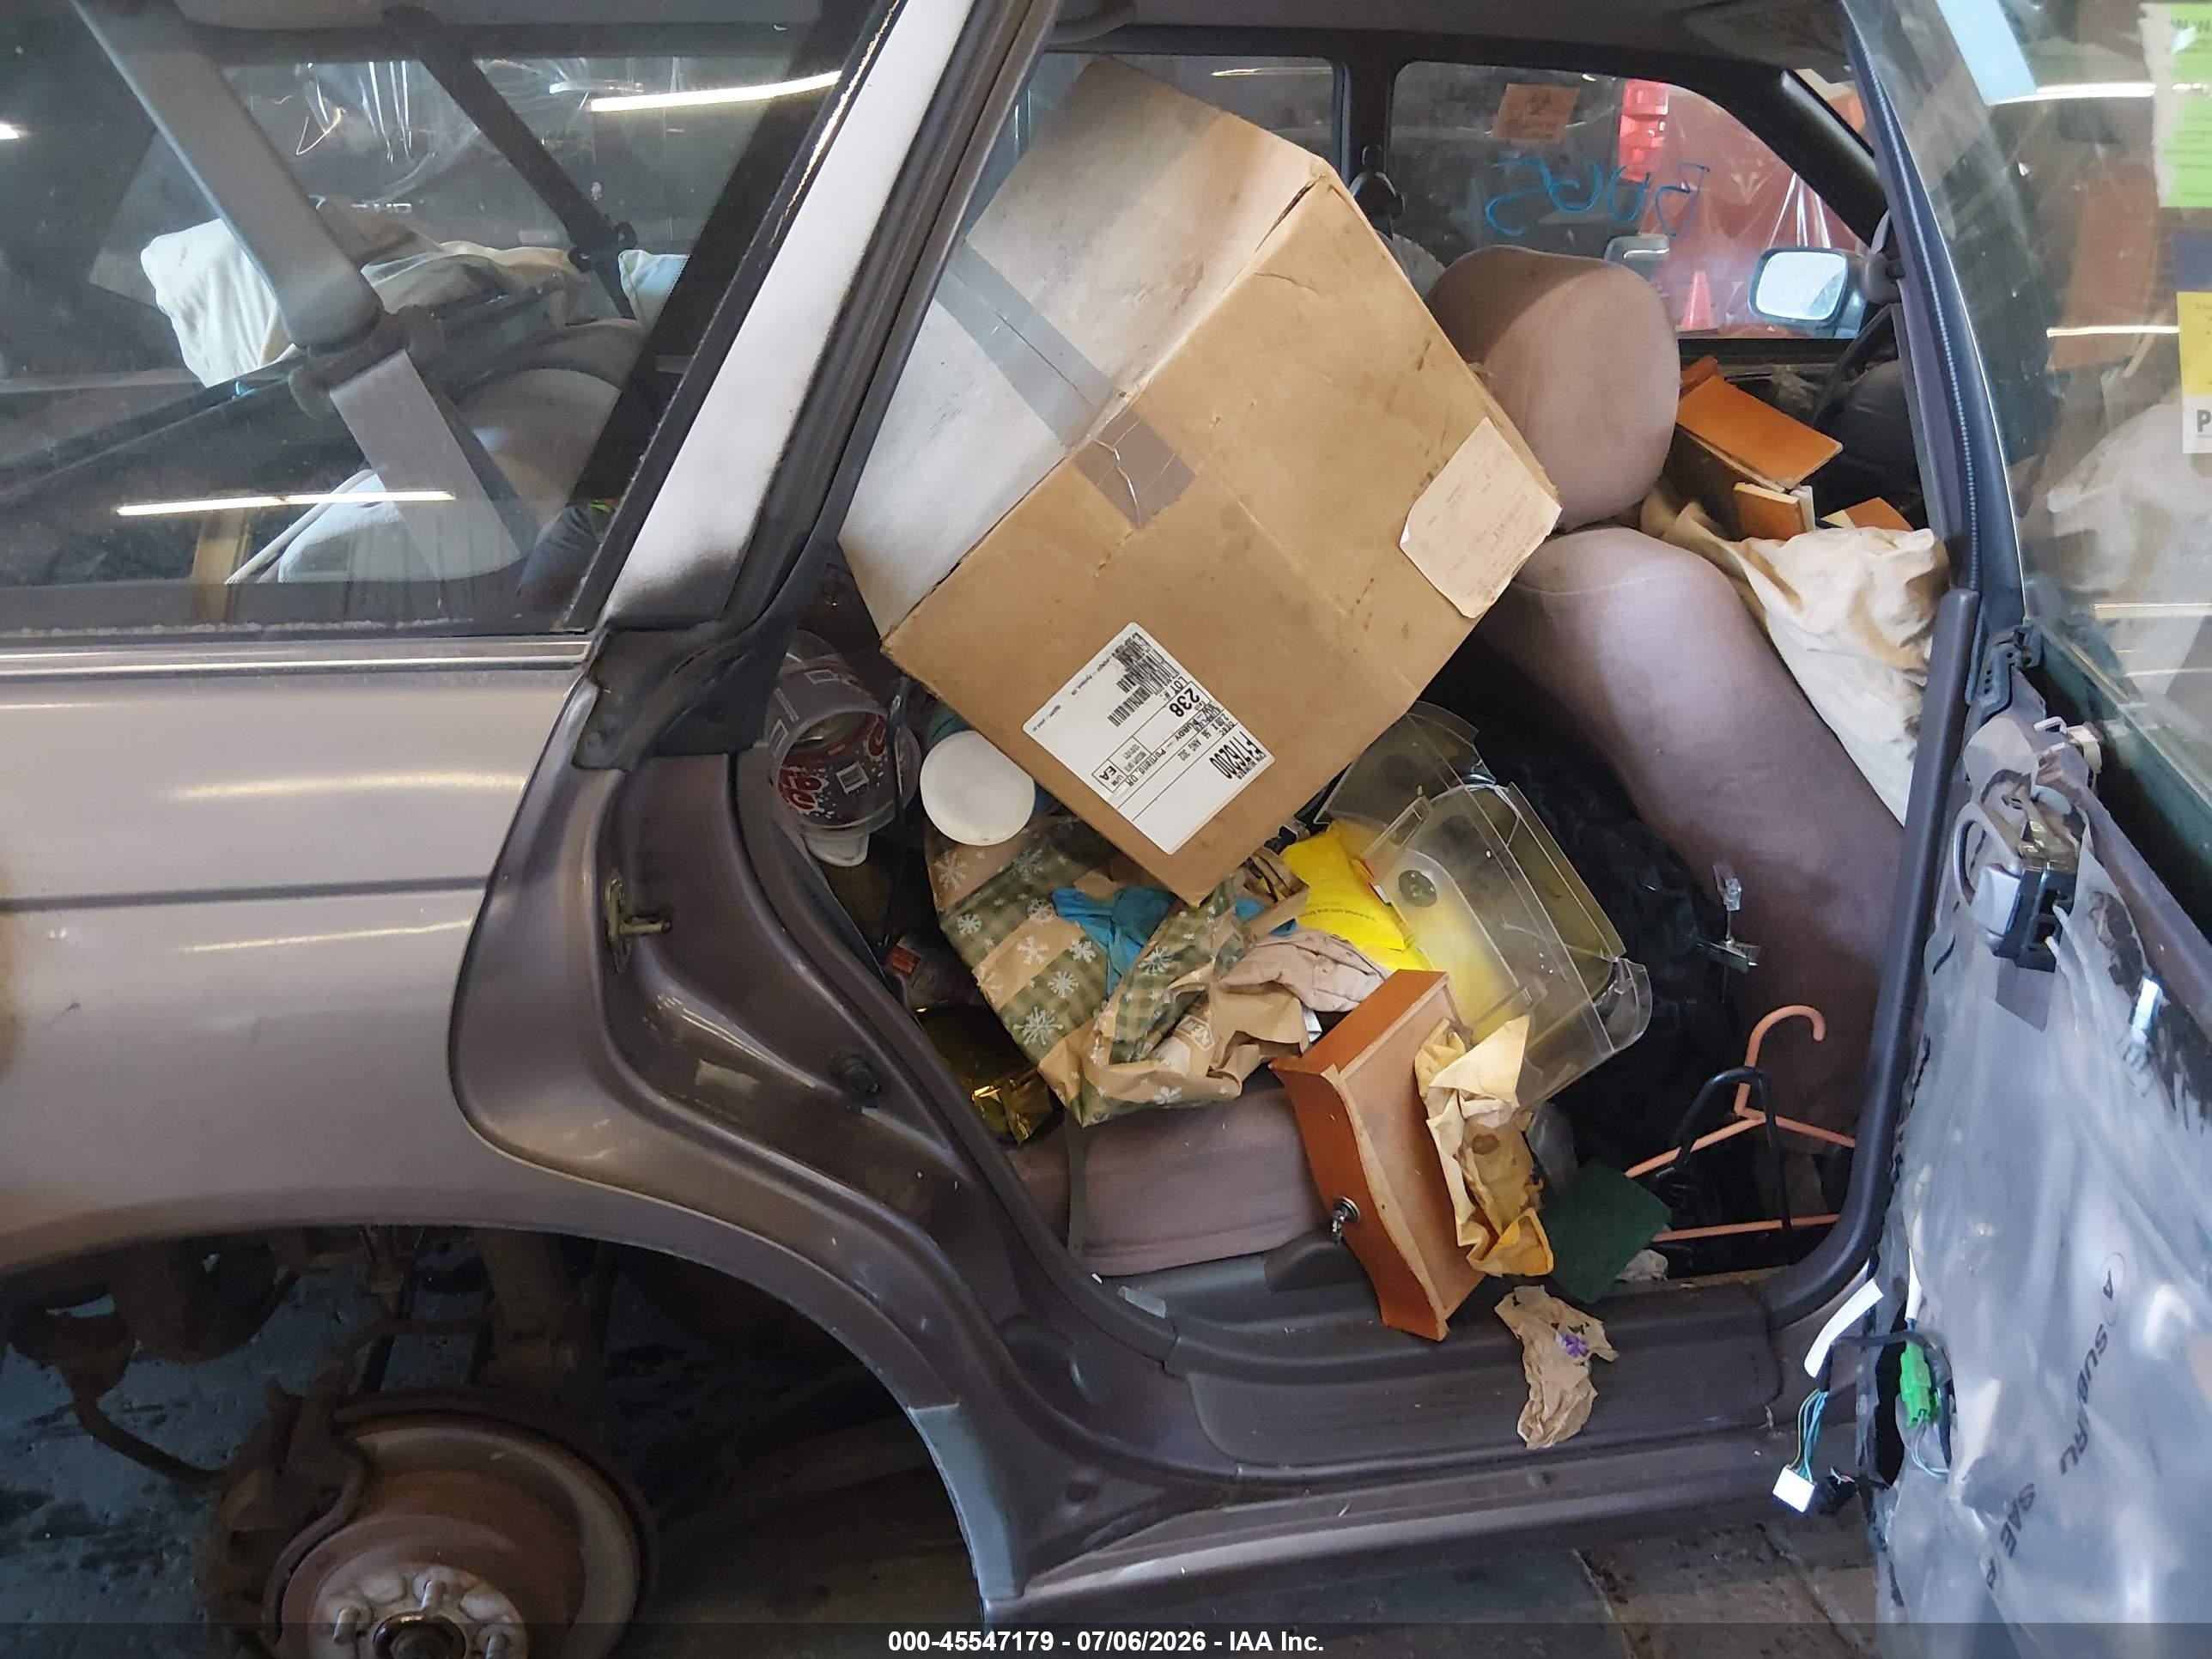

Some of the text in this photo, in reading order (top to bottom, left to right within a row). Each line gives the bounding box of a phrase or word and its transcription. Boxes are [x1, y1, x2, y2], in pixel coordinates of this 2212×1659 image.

[1170, 677, 1188, 694] LOT
[1170, 687, 1200, 717] 238
[1209, 731, 1261, 779] F176200
[1099, 766, 1116, 781] EA
[2058, 1323, 2108, 1476] SUBARU
